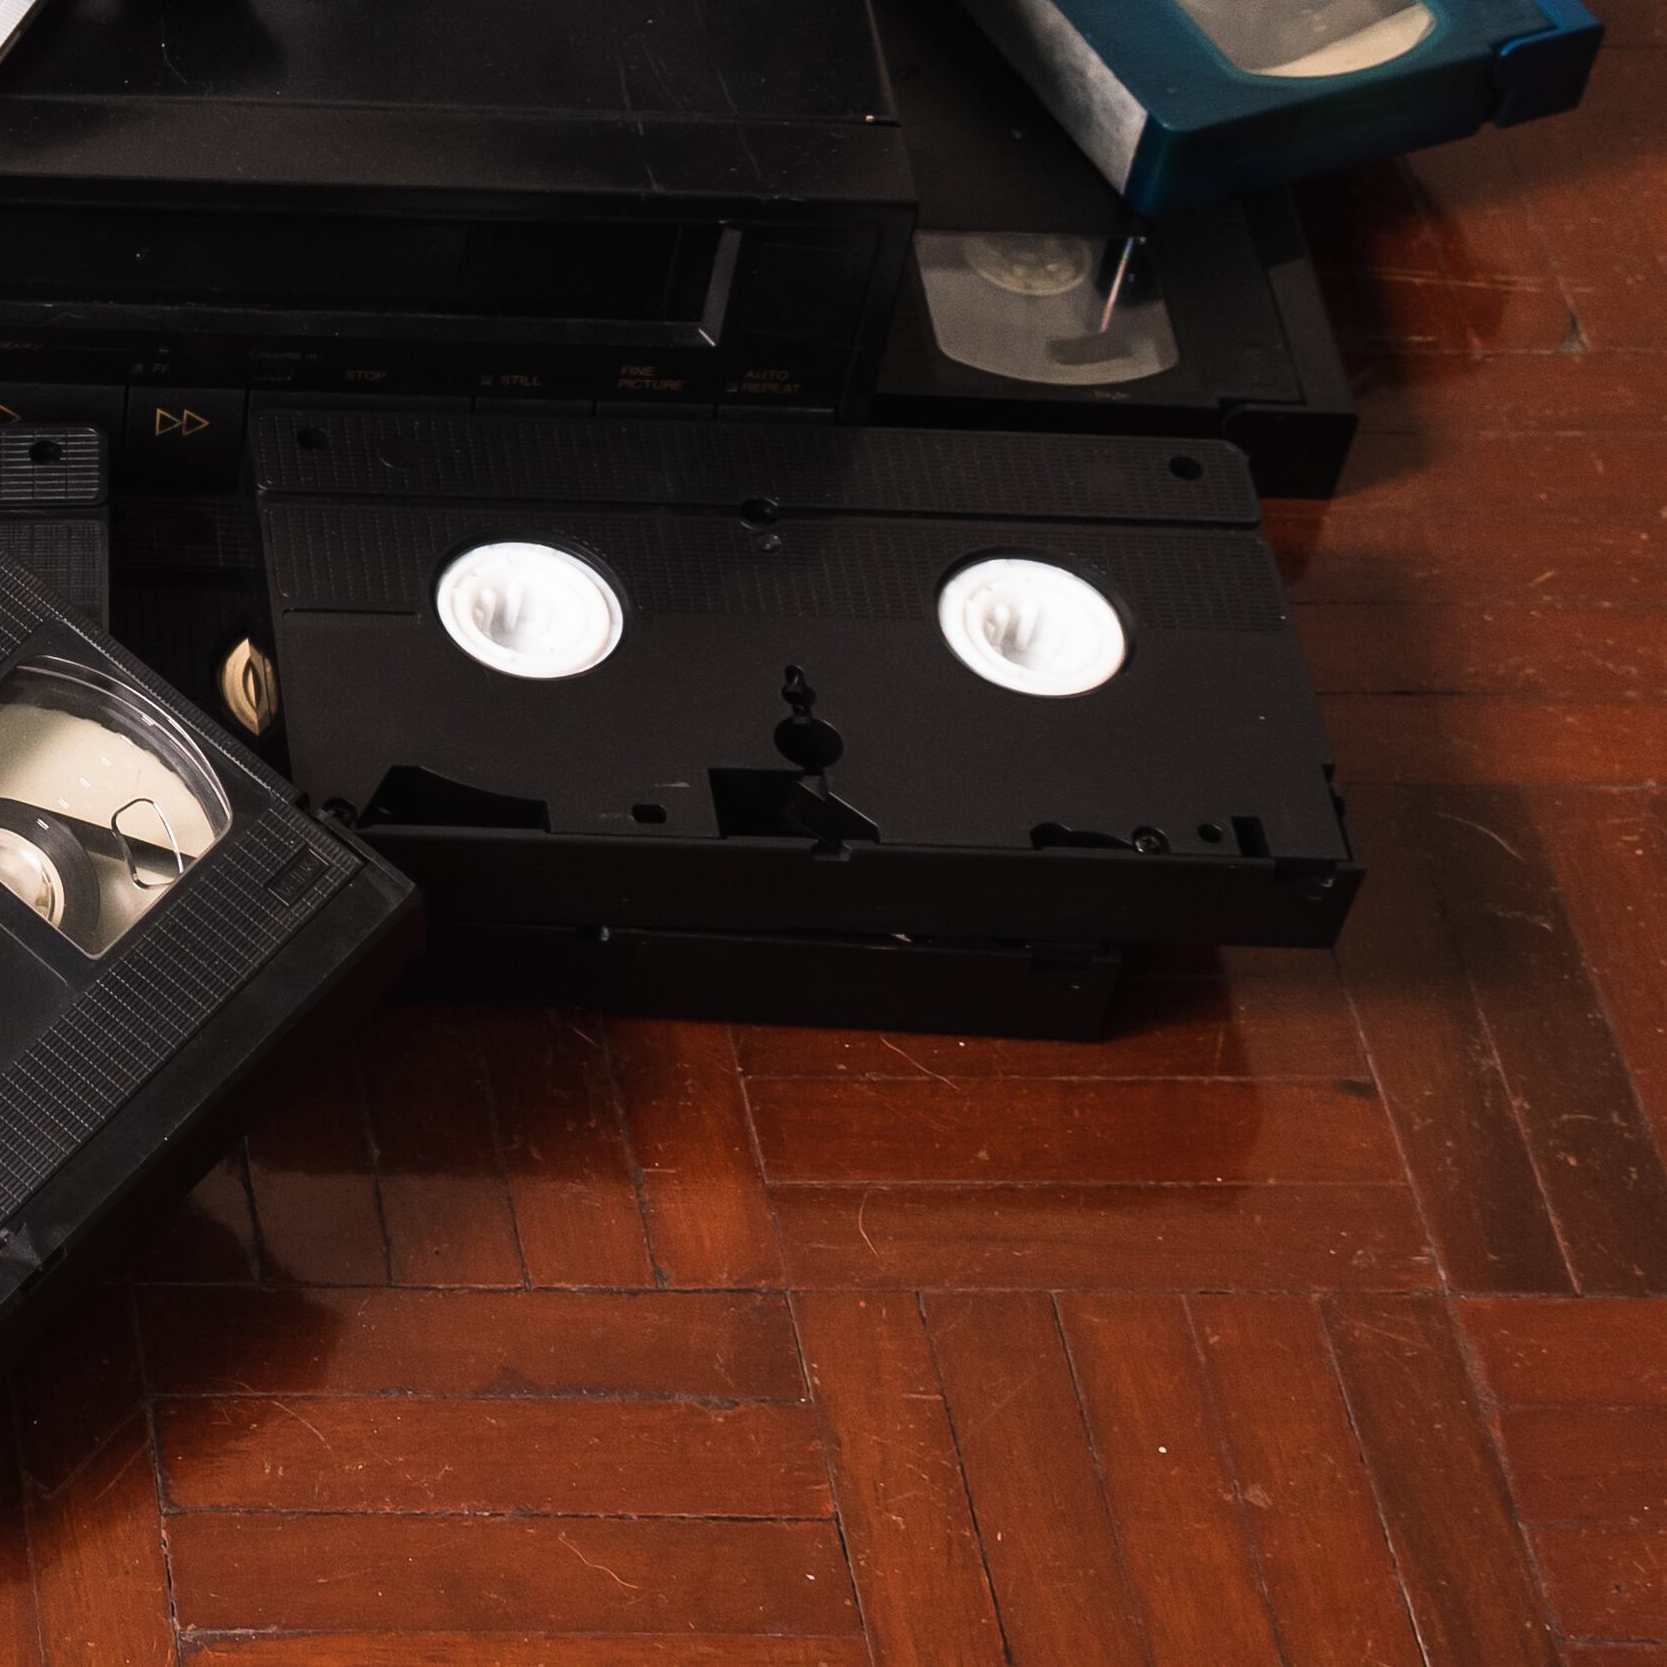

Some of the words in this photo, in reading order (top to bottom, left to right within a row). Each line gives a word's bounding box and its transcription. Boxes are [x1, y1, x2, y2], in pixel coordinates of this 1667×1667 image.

[152, 363, 171, 374] FF
[620, 366, 655, 377] FINE
[345, 369, 387, 381] STOP
[498, 374, 542, 387] STILL
[745, 369, 790, 382] AUTO
[618, 379, 684, 391] PICTURE
[740, 381, 803, 395] REPEAT
